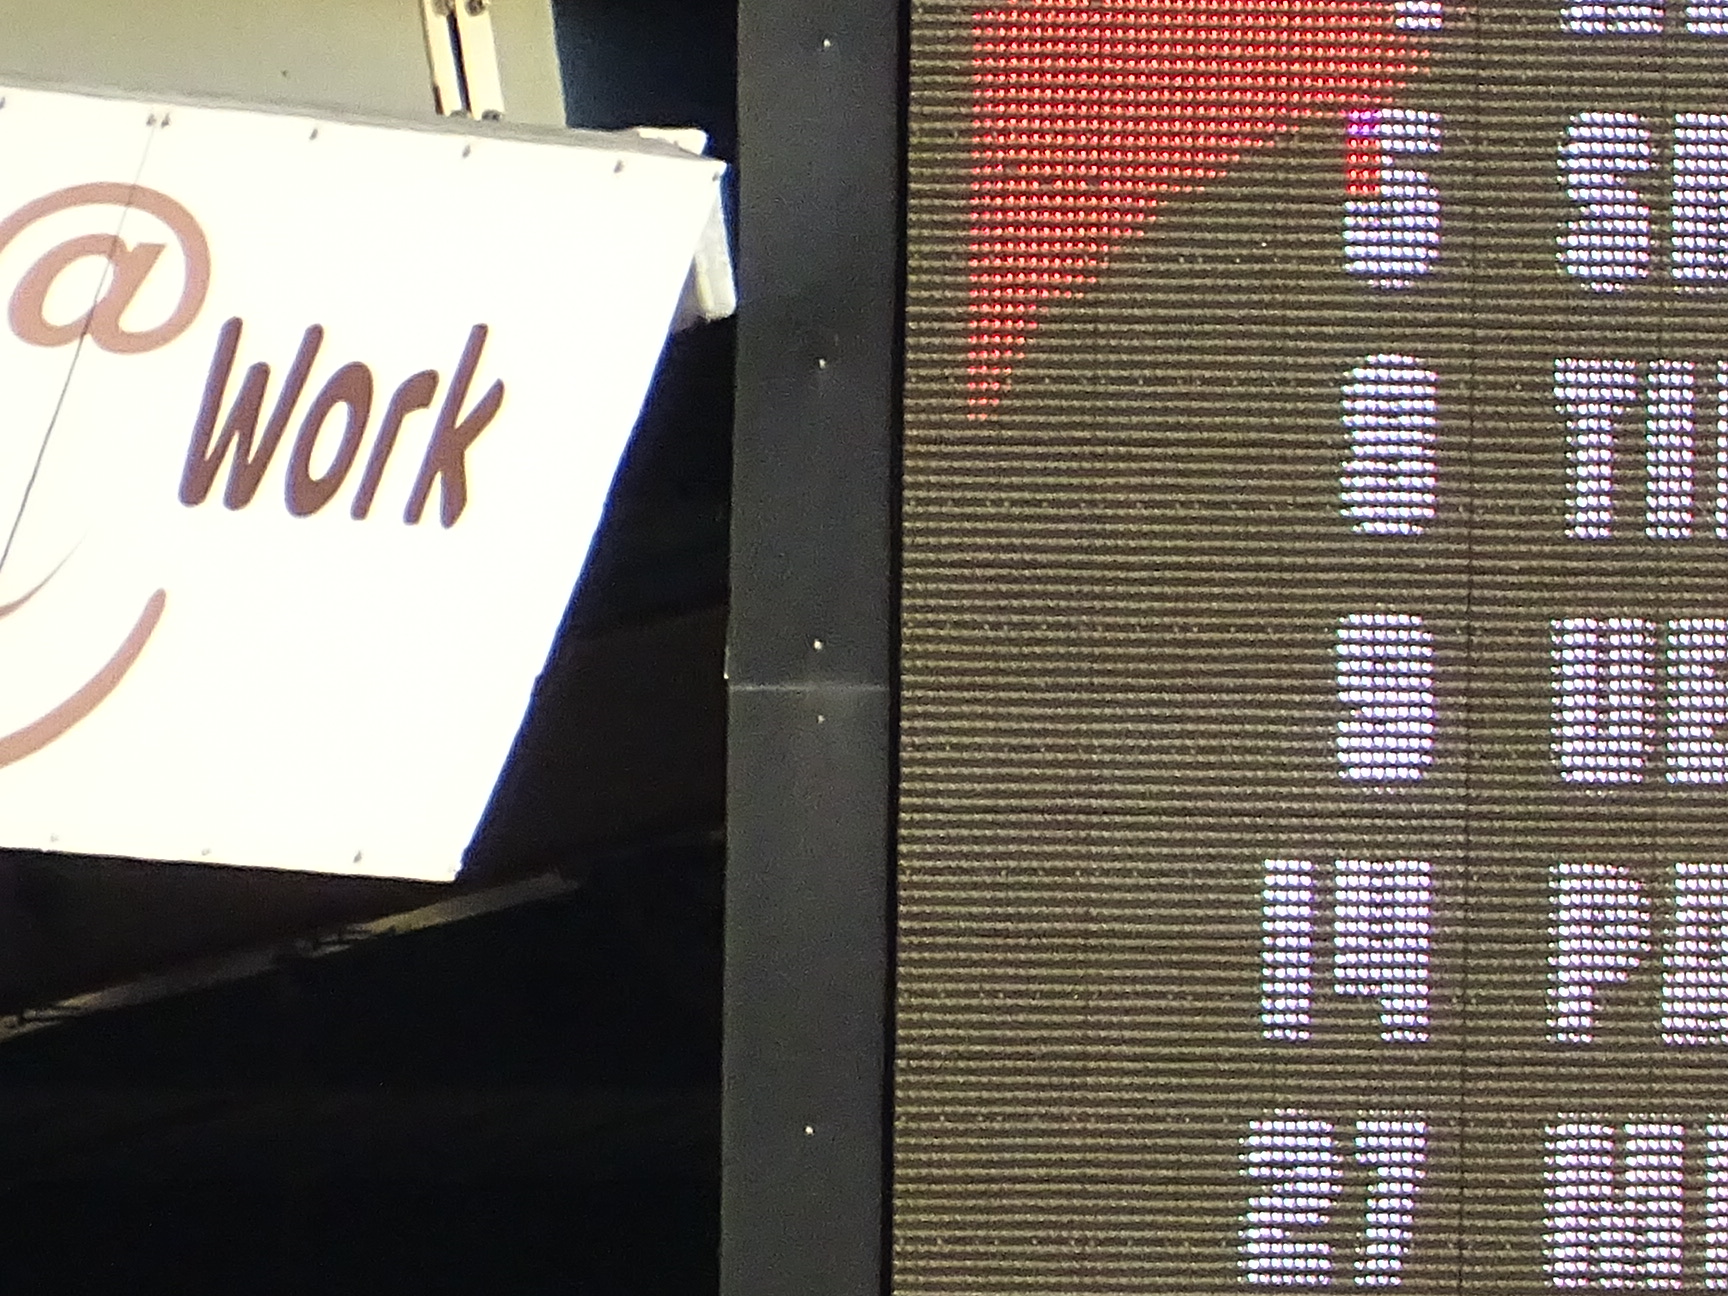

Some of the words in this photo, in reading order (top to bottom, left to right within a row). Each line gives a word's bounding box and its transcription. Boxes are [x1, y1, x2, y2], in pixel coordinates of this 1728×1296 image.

[1343, 107, 1441, 288] 5
[178, 315, 506, 530] Work
[1338, 353, 1437, 535] 8
[1335, 613, 1434, 795] 9
[1260, 858, 1431, 1042] 14
[1237, 1107, 1426, 1286] 27
